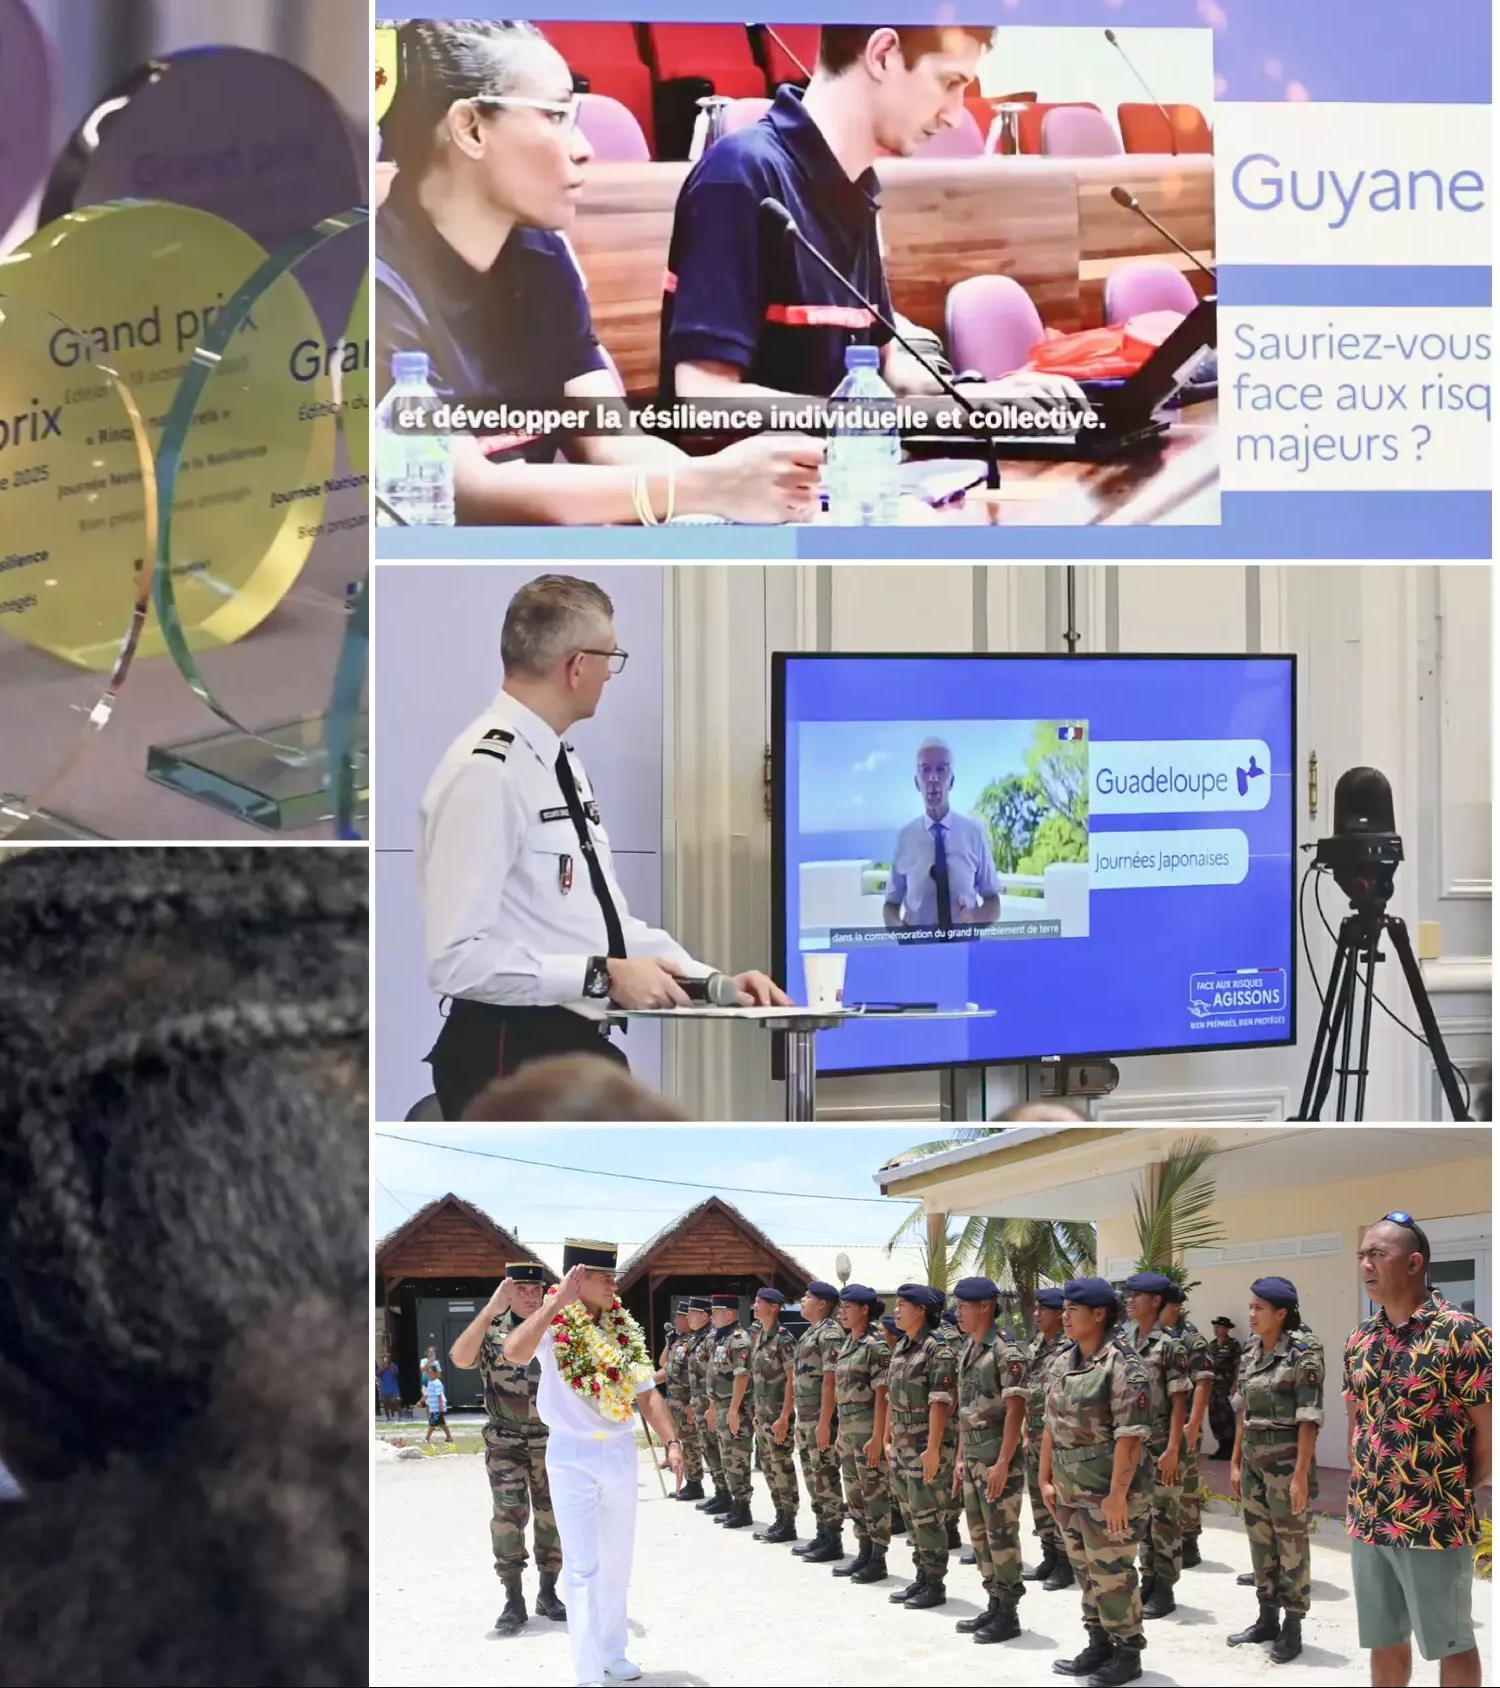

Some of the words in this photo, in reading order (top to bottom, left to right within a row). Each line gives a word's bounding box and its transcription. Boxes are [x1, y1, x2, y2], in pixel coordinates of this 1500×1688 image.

[1232, 152, 1485, 229] Guyane
[50, 304, 162, 368] Grand
[176, 292, 258, 352] prx
[1233, 322, 1492, 361] Sauriez-vous
[1233, 371, 1322, 411] face
[1336, 380, 1407, 411] aux
[1421, 372, 1492, 422] risq
[399, 406, 426, 429] et
[432, 404, 590, 434] développer
[596, 404, 622, 429] la
[628, 404, 762, 429] résilience
[770, 405, 927, 429] individuelle
[936, 409, 963, 429] et
[969, 405, 1106, 429] collective.
[1235, 423, 1399, 473] majeurs
[1411, 424, 1431, 461] ?
[12, 464, 50, 488] 2025
[270, 483, 320, 508] Journée
[1096, 766, 1228, 800] Guadeloupe
[1095, 851, 1156, 873] Journées
[1157, 849, 1229, 872] Japonaises
[832, 933, 853, 943] dans
[855, 932, 863, 942] la
[864, 929, 933, 942] commémoration
[934, 928, 945, 938] du
[947, 927, 972, 940] grand
[1027, 924, 1038, 934] de
[1039, 923, 1059, 933] terre
[1196, 981, 1215, 991] FACE
[1215, 980, 1231, 989] AUX
[1232, 978, 1263, 989] RISQUES
[1212, 988, 1280, 1008] AGISSONS
